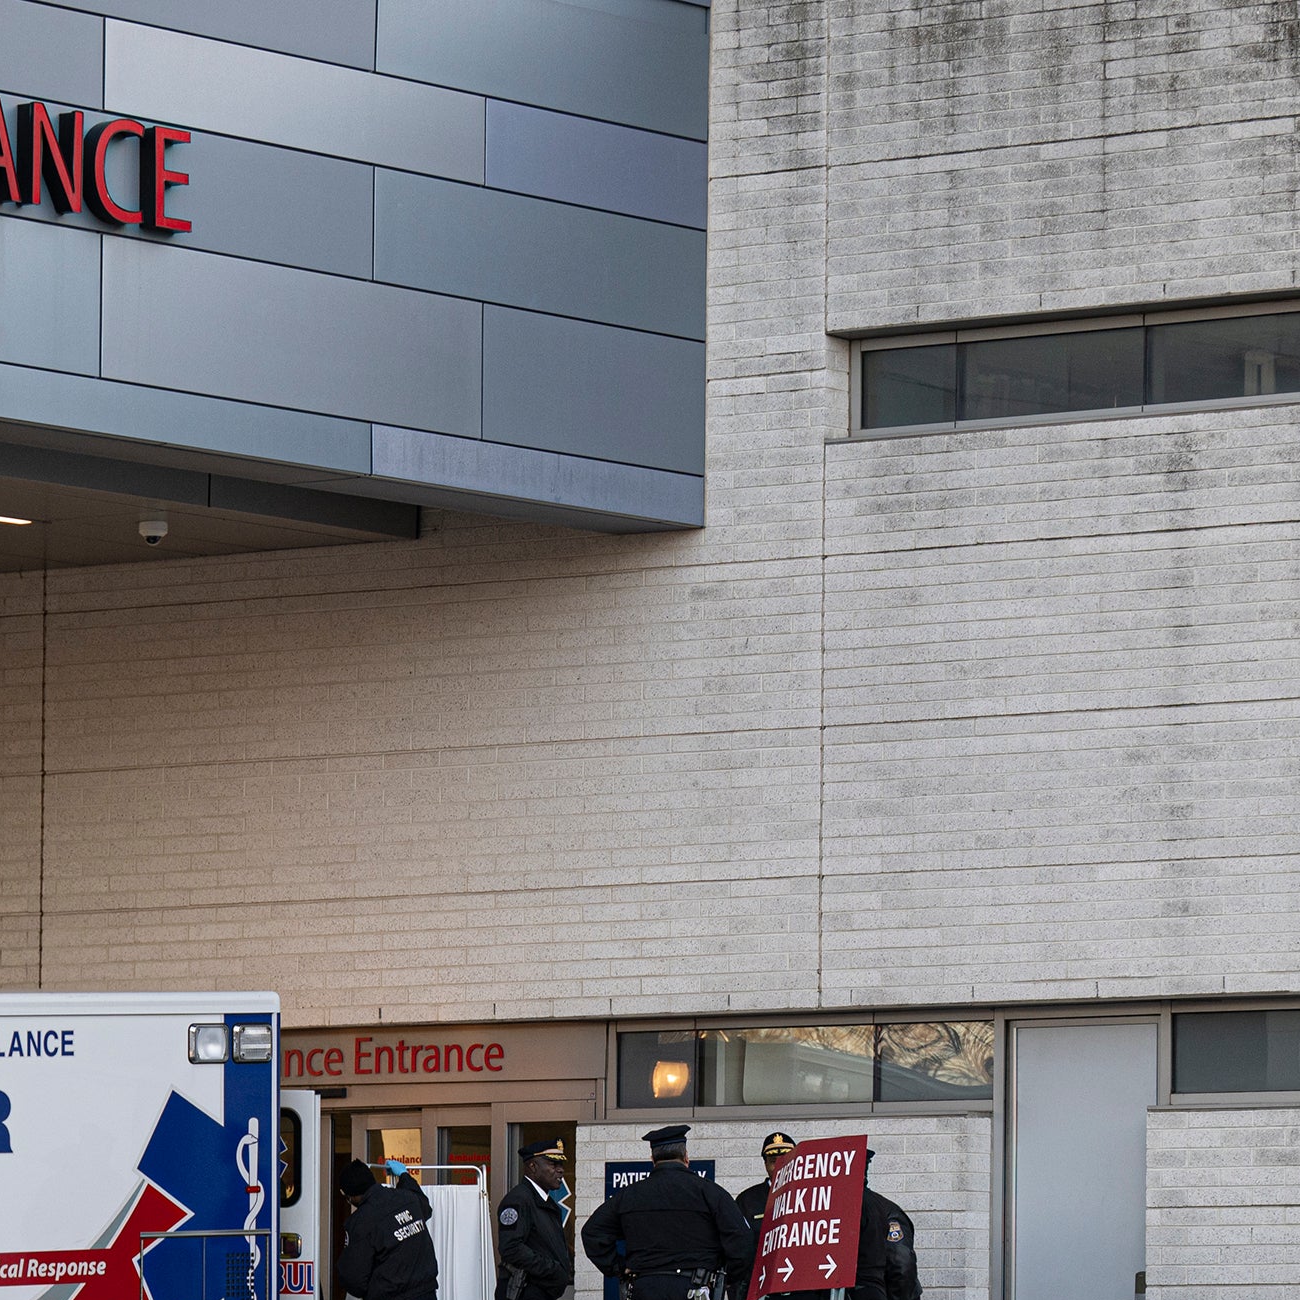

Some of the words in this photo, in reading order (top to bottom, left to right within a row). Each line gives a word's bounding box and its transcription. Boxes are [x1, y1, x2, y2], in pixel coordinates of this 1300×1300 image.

[355, 1037, 504, 1075] Entrance
[772, 1150, 856, 1193] EMERGENCY
[394, 1210, 413, 1225] PPMC
[772, 1188, 807, 1221] WALK
[811, 1186, 832, 1212] IN
[393, 1219, 425, 1241] SECURITY
[762, 1218, 841, 1257] ENTRANCE
[27, 1259, 107, 1281] Response
